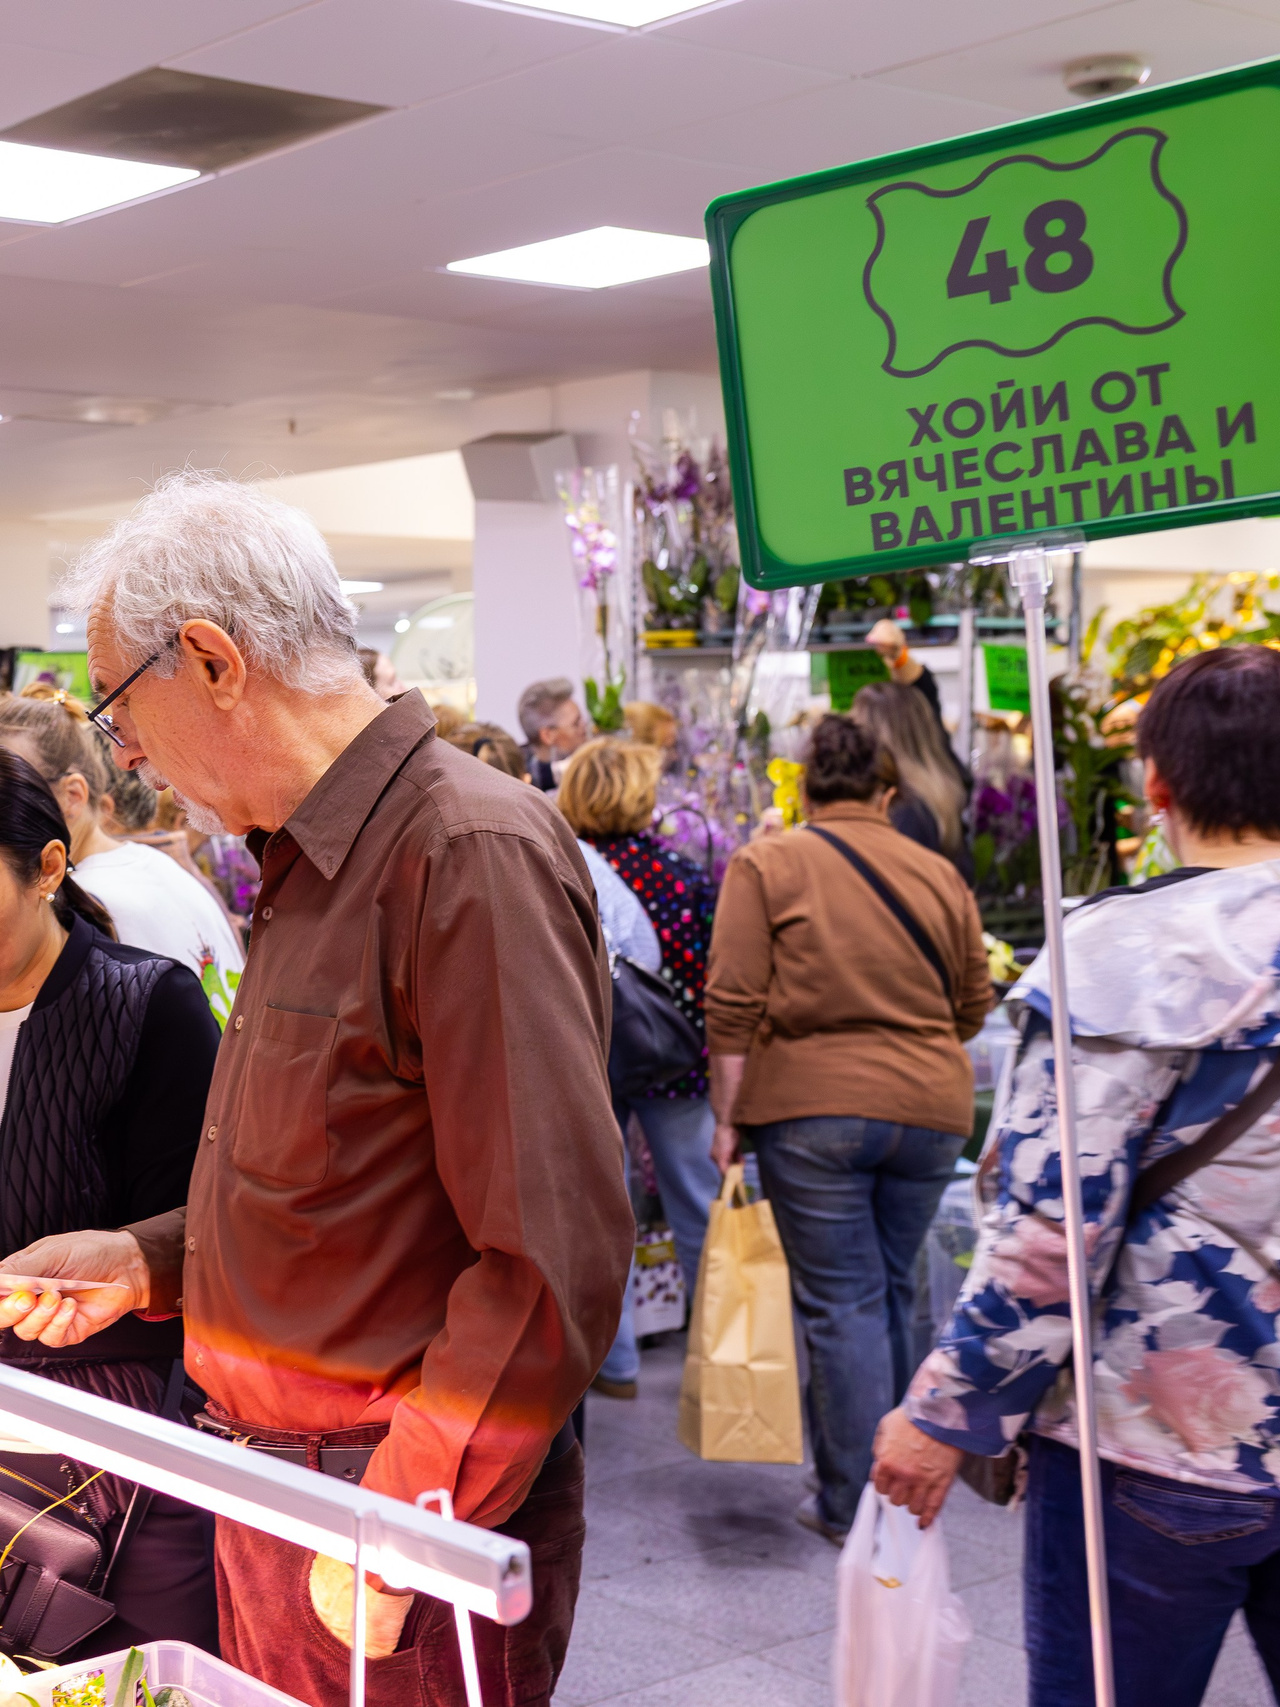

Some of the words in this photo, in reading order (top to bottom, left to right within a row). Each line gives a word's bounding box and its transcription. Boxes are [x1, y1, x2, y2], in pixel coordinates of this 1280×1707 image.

[946, 199, 1095, 305] 48
[843, 413, 1197, 507] ВЯЧЕСЛАВА
[1215, 401, 1258, 449] И
[906, 378, 1070, 448] ХОЙИ
[1090, 361, 1171, 414] ОТ
[869, 458, 1237, 552] ВАЛЕНТИНЫ
